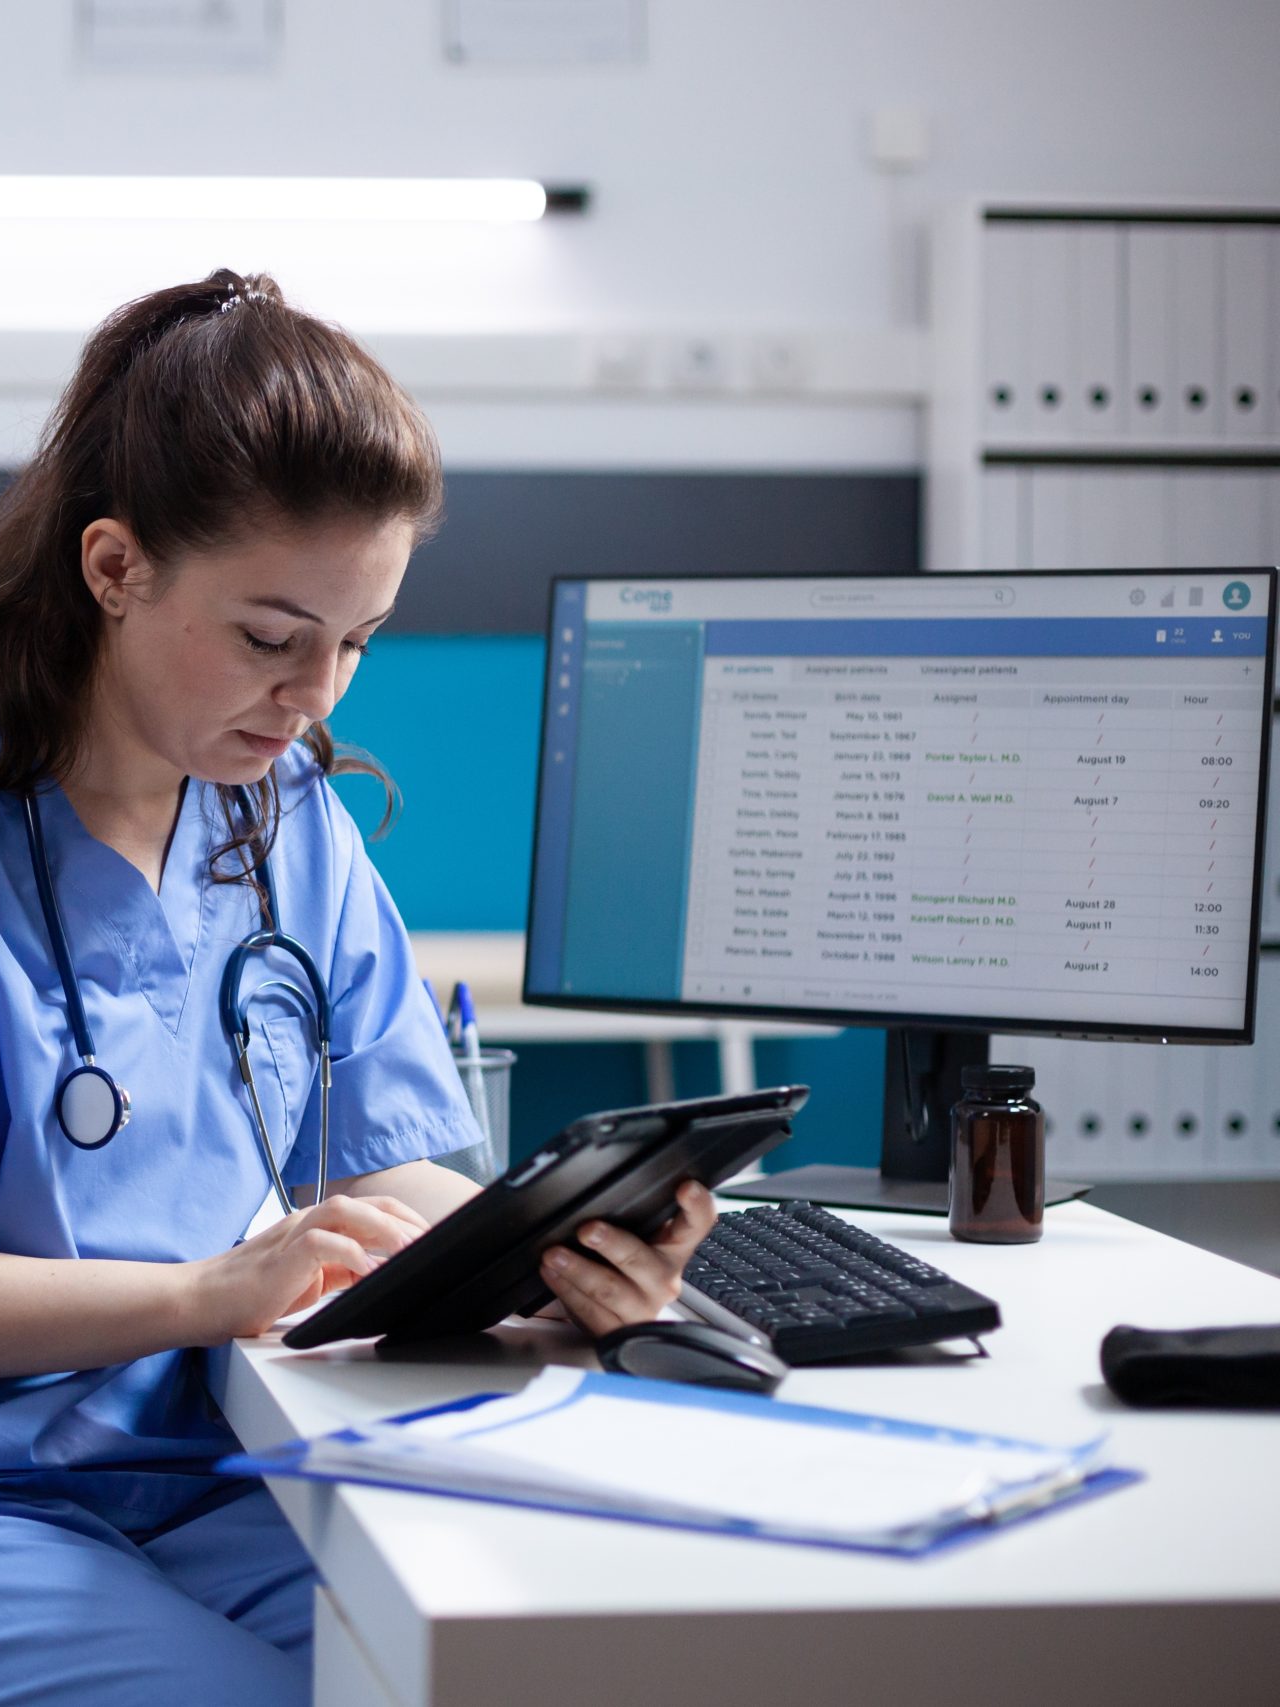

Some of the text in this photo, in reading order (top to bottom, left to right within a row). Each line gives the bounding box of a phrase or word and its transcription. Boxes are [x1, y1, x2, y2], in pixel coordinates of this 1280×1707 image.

[619, 586, 673, 603] Come
[1232, 631, 1251, 640] YOU
[850, 665, 888, 676] patients
[921, 665, 1018, 676] Unassigned patients
[933, 693, 978, 704] Assigned
[1043, 694, 1130, 705] Appointment day
[1183, 695, 1209, 704] Hour
[1077, 755, 1126, 766] August 19
[1201, 757, 1233, 766] 08:00
[1073, 796, 1119, 807] August 7
[1199, 799, 1230, 809] 09:20
[826, 831, 869, 842] February
[1065, 899, 1116, 910] August 28
[1194, 903, 1222, 913] 12:00
[1065, 919, 1112, 931] August 11
[1195, 924, 1220, 935] 11:30
[817, 931, 865, 941] November
[821, 951, 860, 961] October
[1064, 961, 1109, 972] August 2
[1190, 967, 1219, 977] 14:00
